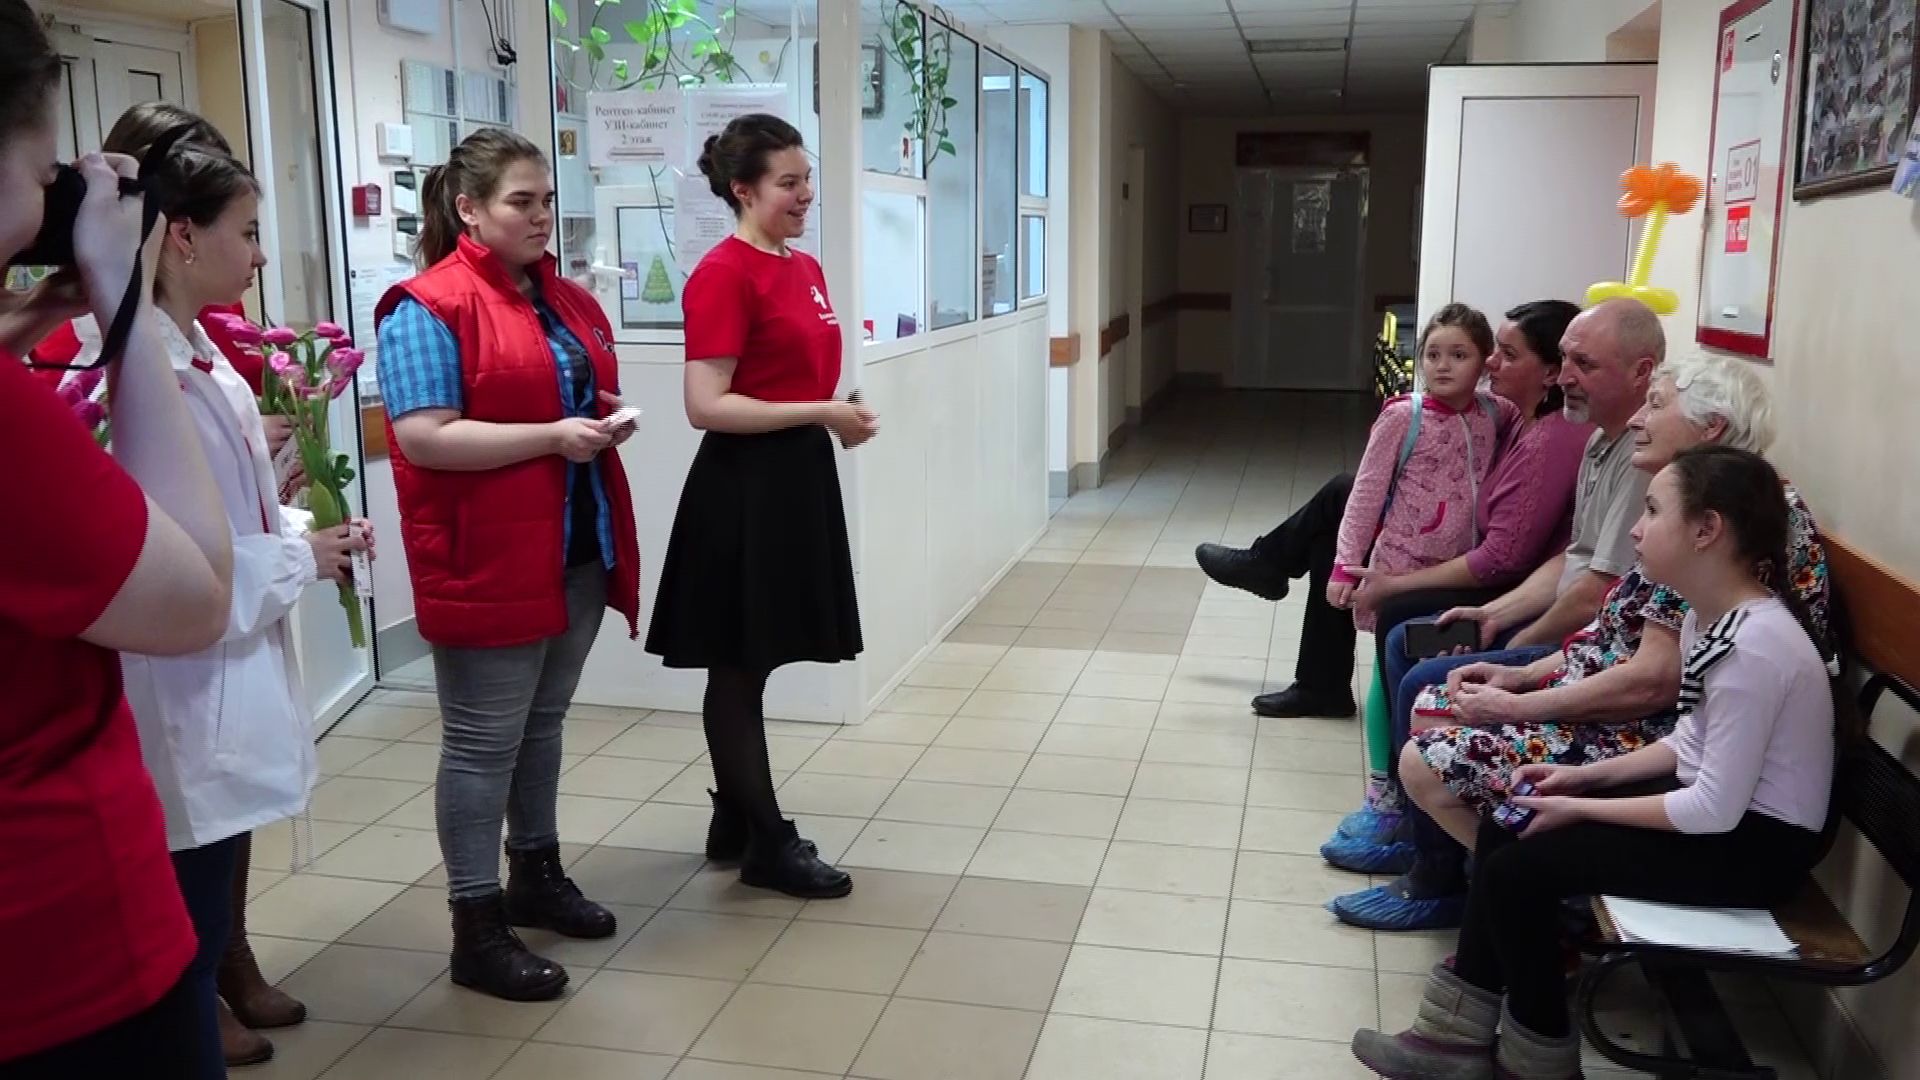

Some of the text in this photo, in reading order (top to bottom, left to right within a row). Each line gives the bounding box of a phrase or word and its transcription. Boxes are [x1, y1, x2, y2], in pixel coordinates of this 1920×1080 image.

[595, 104, 676, 116] Рентген-кабинет
[604, 119, 668, 130] УЗИ-кабинет
[621, 134, 653, 145] 2 этаж
